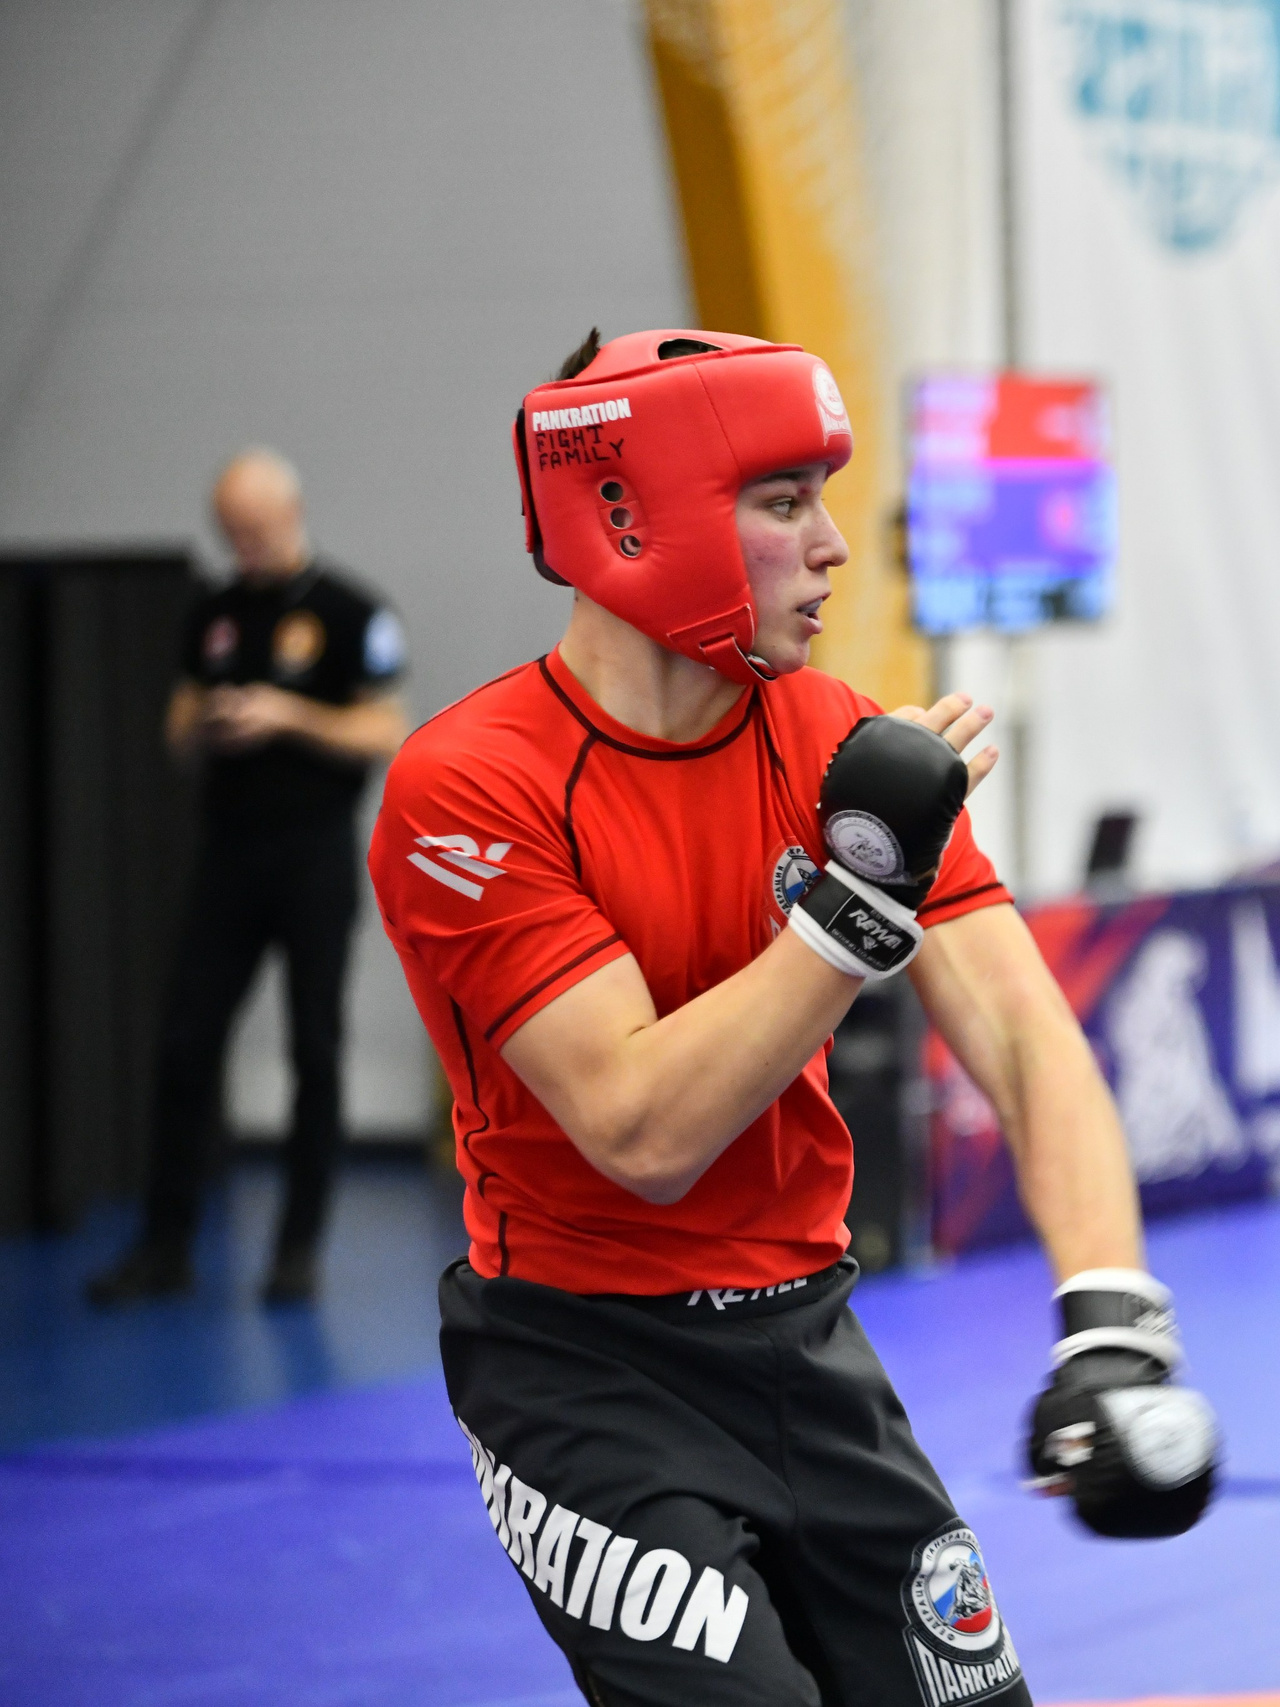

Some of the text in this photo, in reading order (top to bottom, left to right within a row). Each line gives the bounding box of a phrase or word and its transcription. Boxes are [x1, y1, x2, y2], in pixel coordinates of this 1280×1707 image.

[532, 398, 632, 431] PANKRATION
[536, 424, 604, 453] FIGHT
[540, 438, 624, 471] FAMILY
